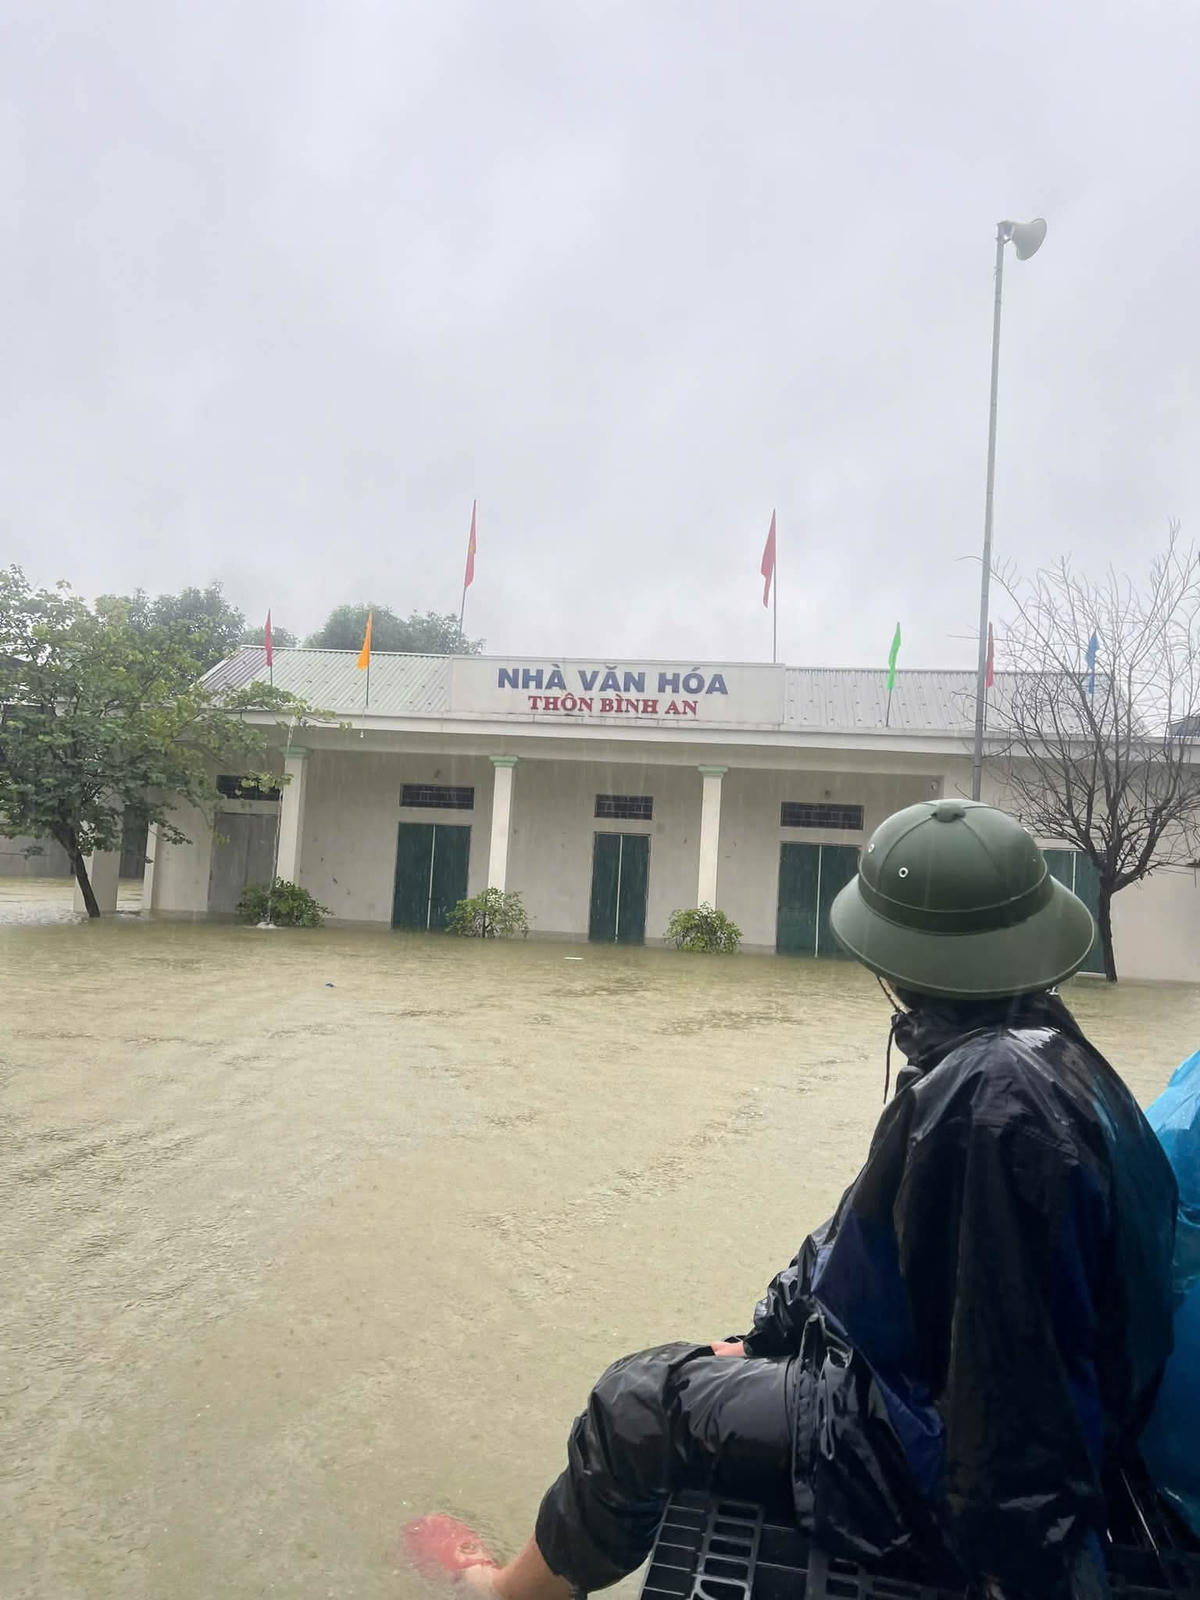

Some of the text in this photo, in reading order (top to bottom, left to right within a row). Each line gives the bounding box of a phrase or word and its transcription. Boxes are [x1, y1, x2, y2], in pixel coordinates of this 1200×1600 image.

[497, 664, 729, 695] NHÀ VĂN HÓA
[528, 693, 699, 716] THÔN BÌNH AN
